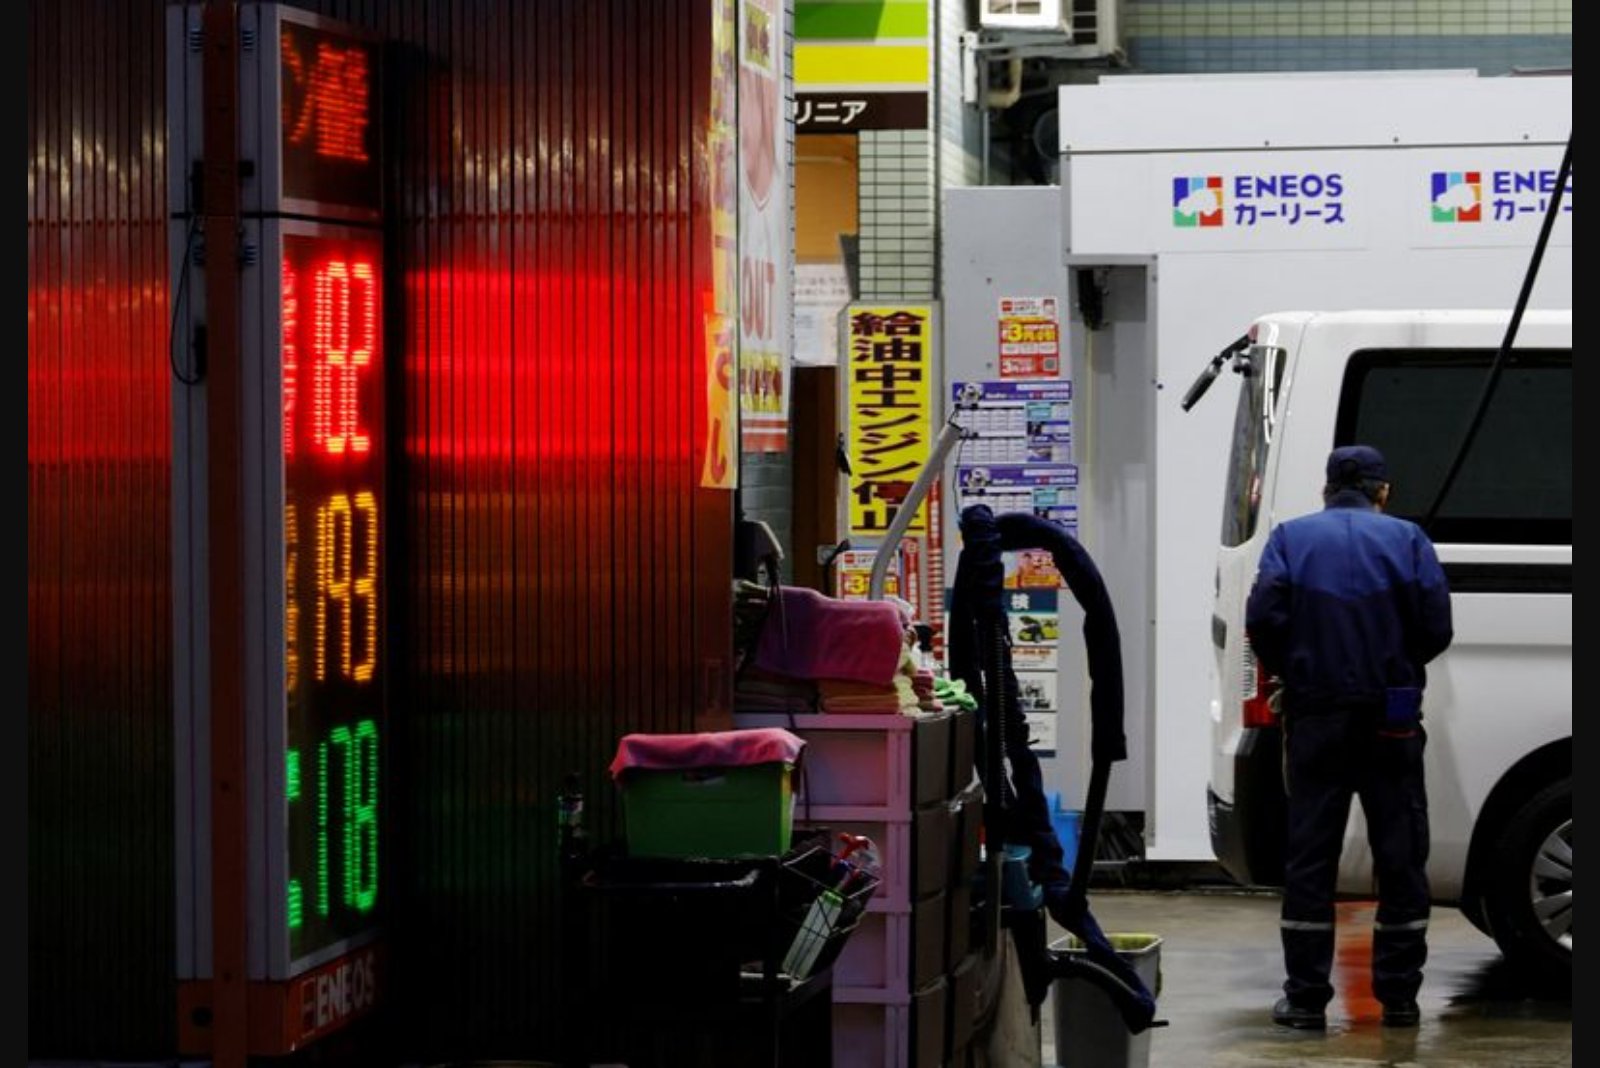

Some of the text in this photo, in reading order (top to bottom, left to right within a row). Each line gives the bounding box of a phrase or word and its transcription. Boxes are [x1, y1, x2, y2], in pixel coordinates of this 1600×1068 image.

[1234, 174, 1344, 198] ENEOS
[1234, 203, 1345, 225] カーリース
[851, 311, 925, 530] 給油中エンジン停止
[317, 949, 375, 1028] ENEOS
